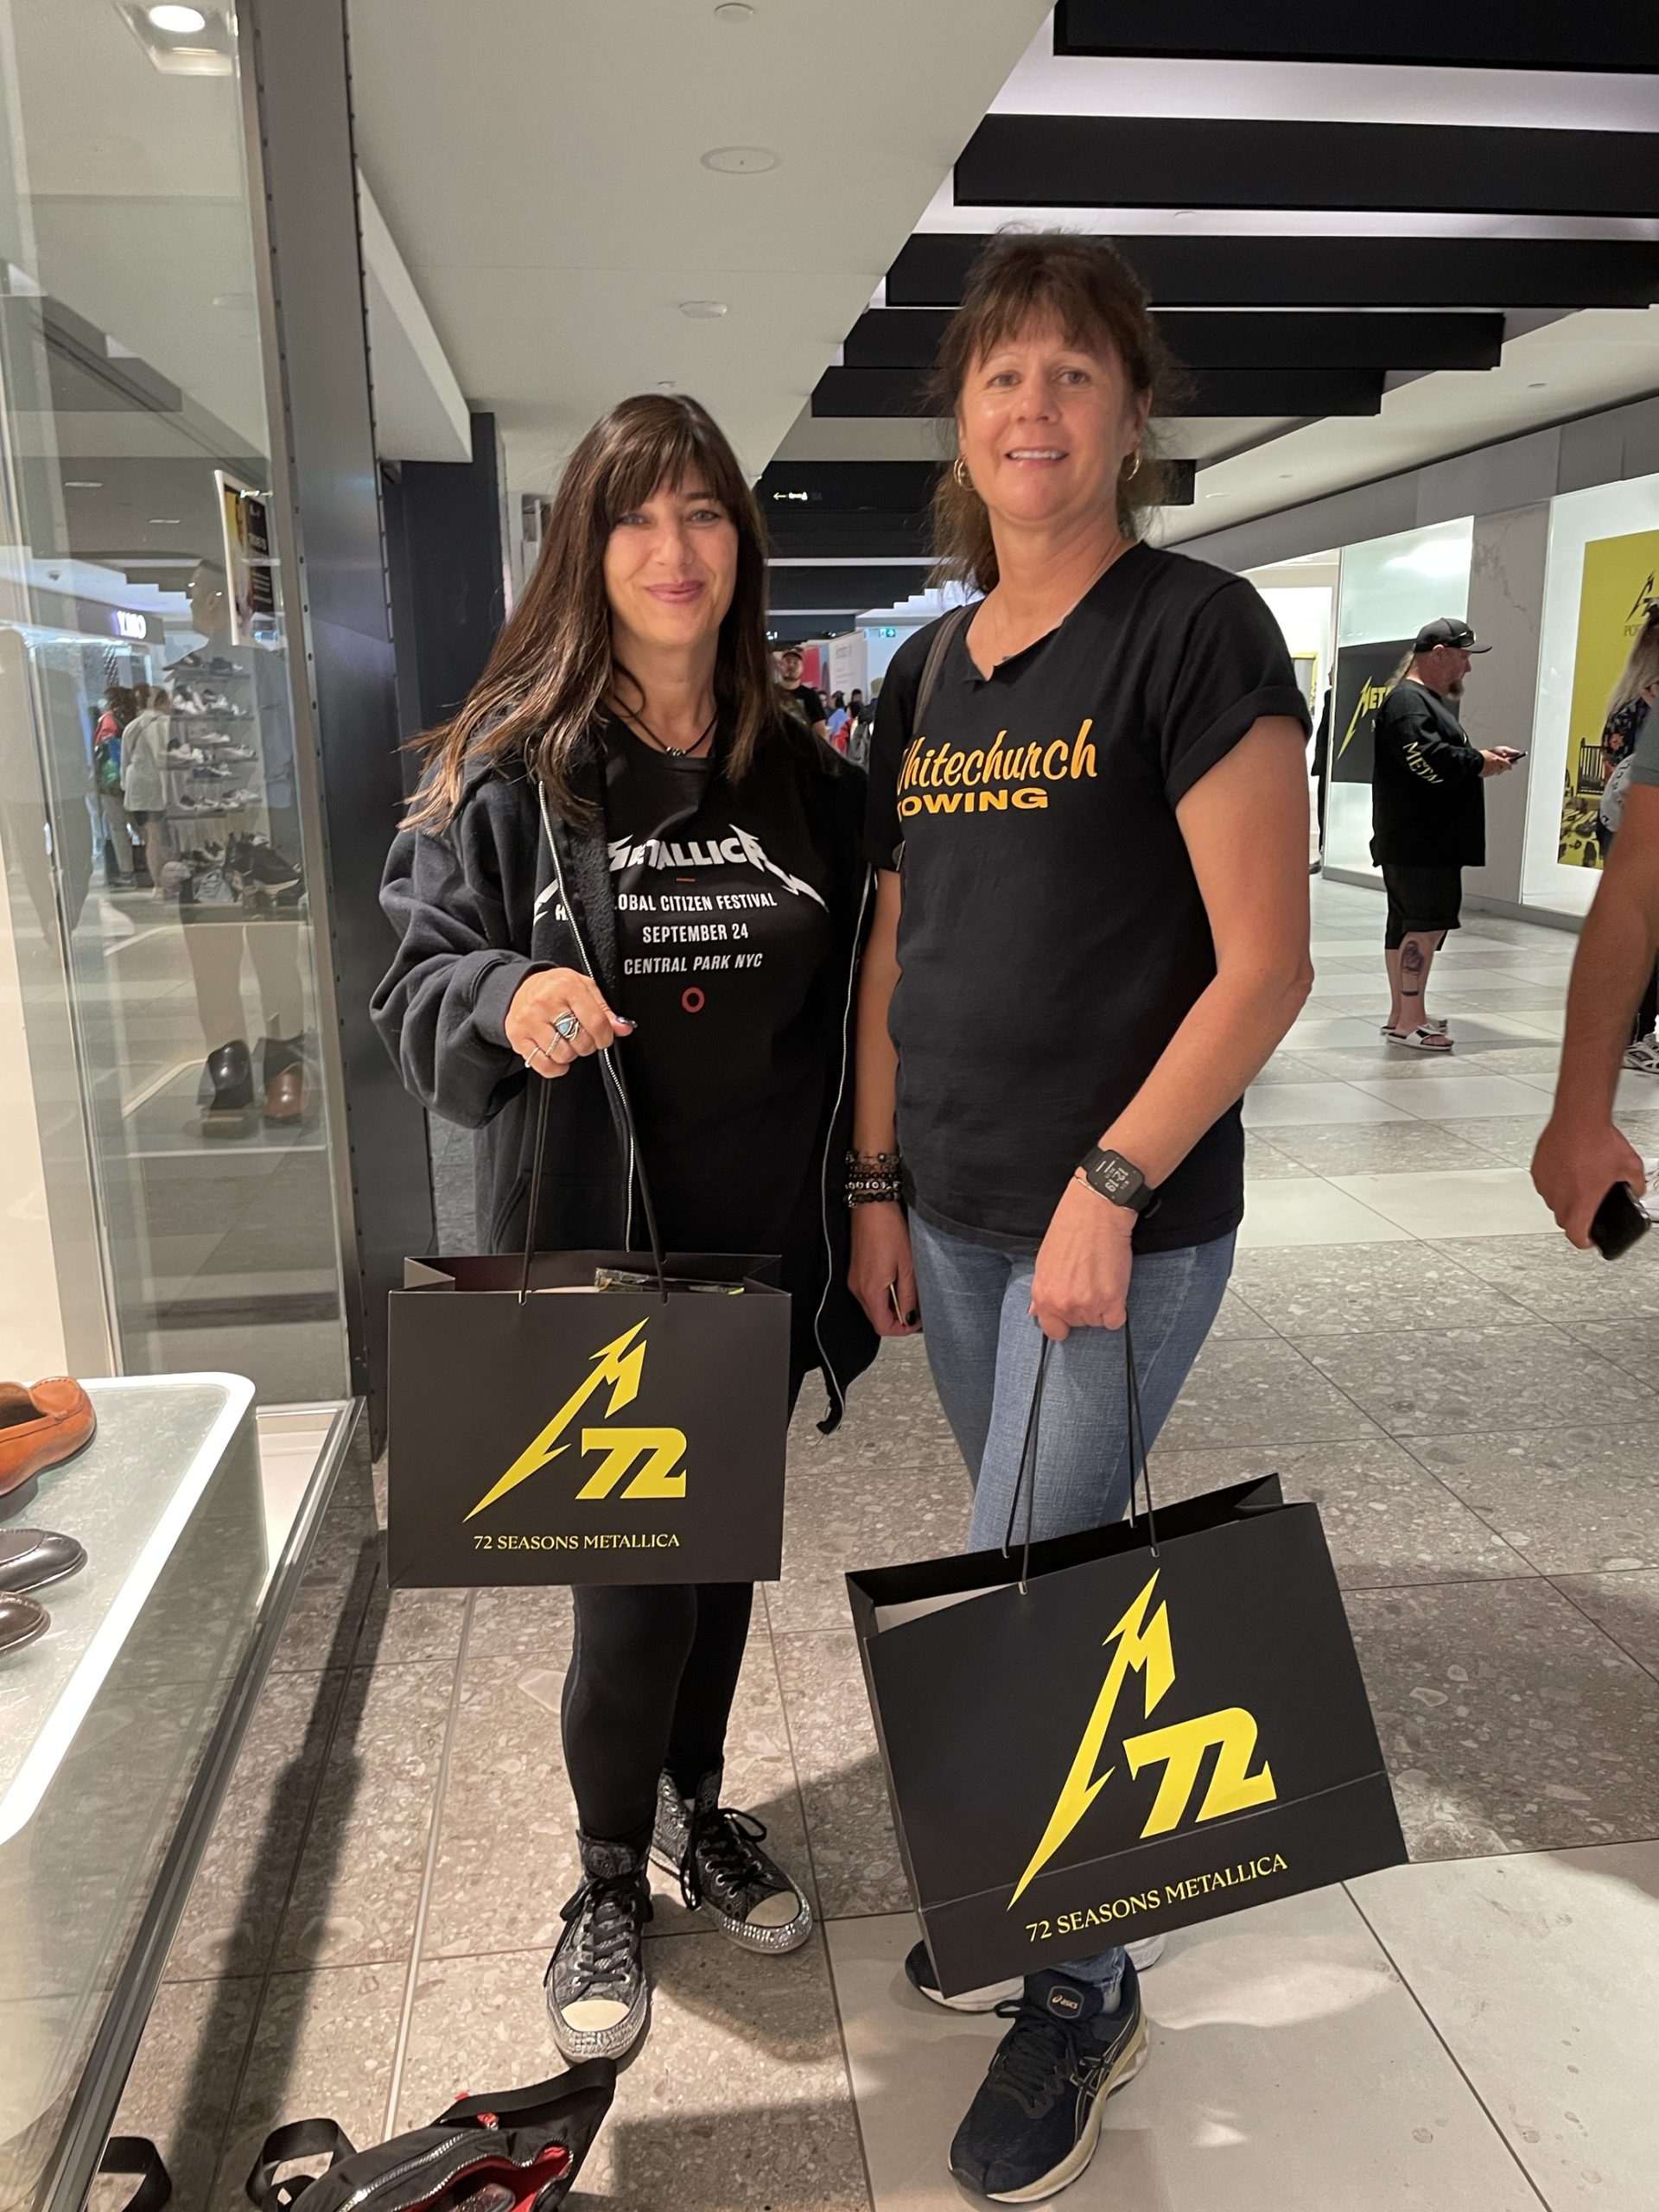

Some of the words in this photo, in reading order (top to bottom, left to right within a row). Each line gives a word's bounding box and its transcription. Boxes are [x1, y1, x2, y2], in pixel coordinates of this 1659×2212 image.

[1337, 676, 1392, 761] MET
[897, 787, 1048, 823] OWING
[614, 893, 657, 911] OBAL
[660, 895, 713, 912] CITIZEN
[715, 893, 778, 910] FESTIVAL
[642, 925, 728, 944] SEPTEMBER
[732, 923, 749, 939] 24
[624, 957, 688, 976] CENTRAL
[692, 955, 730, 971] PARK
[734, 953, 763, 969] NYC
[575, 1427, 687, 1500] 72
[474, 1535, 493, 1550] 72
[497, 1535, 579, 1550] SEASONS
[583, 1534, 680, 1549] METALLICA
[1122, 1707, 1277, 1839] 72
[1026, 1923, 1052, 1942] 72
[1057, 1890, 1161, 1935] SEASONS
[1164, 1853, 1288, 1904] METALLICA
